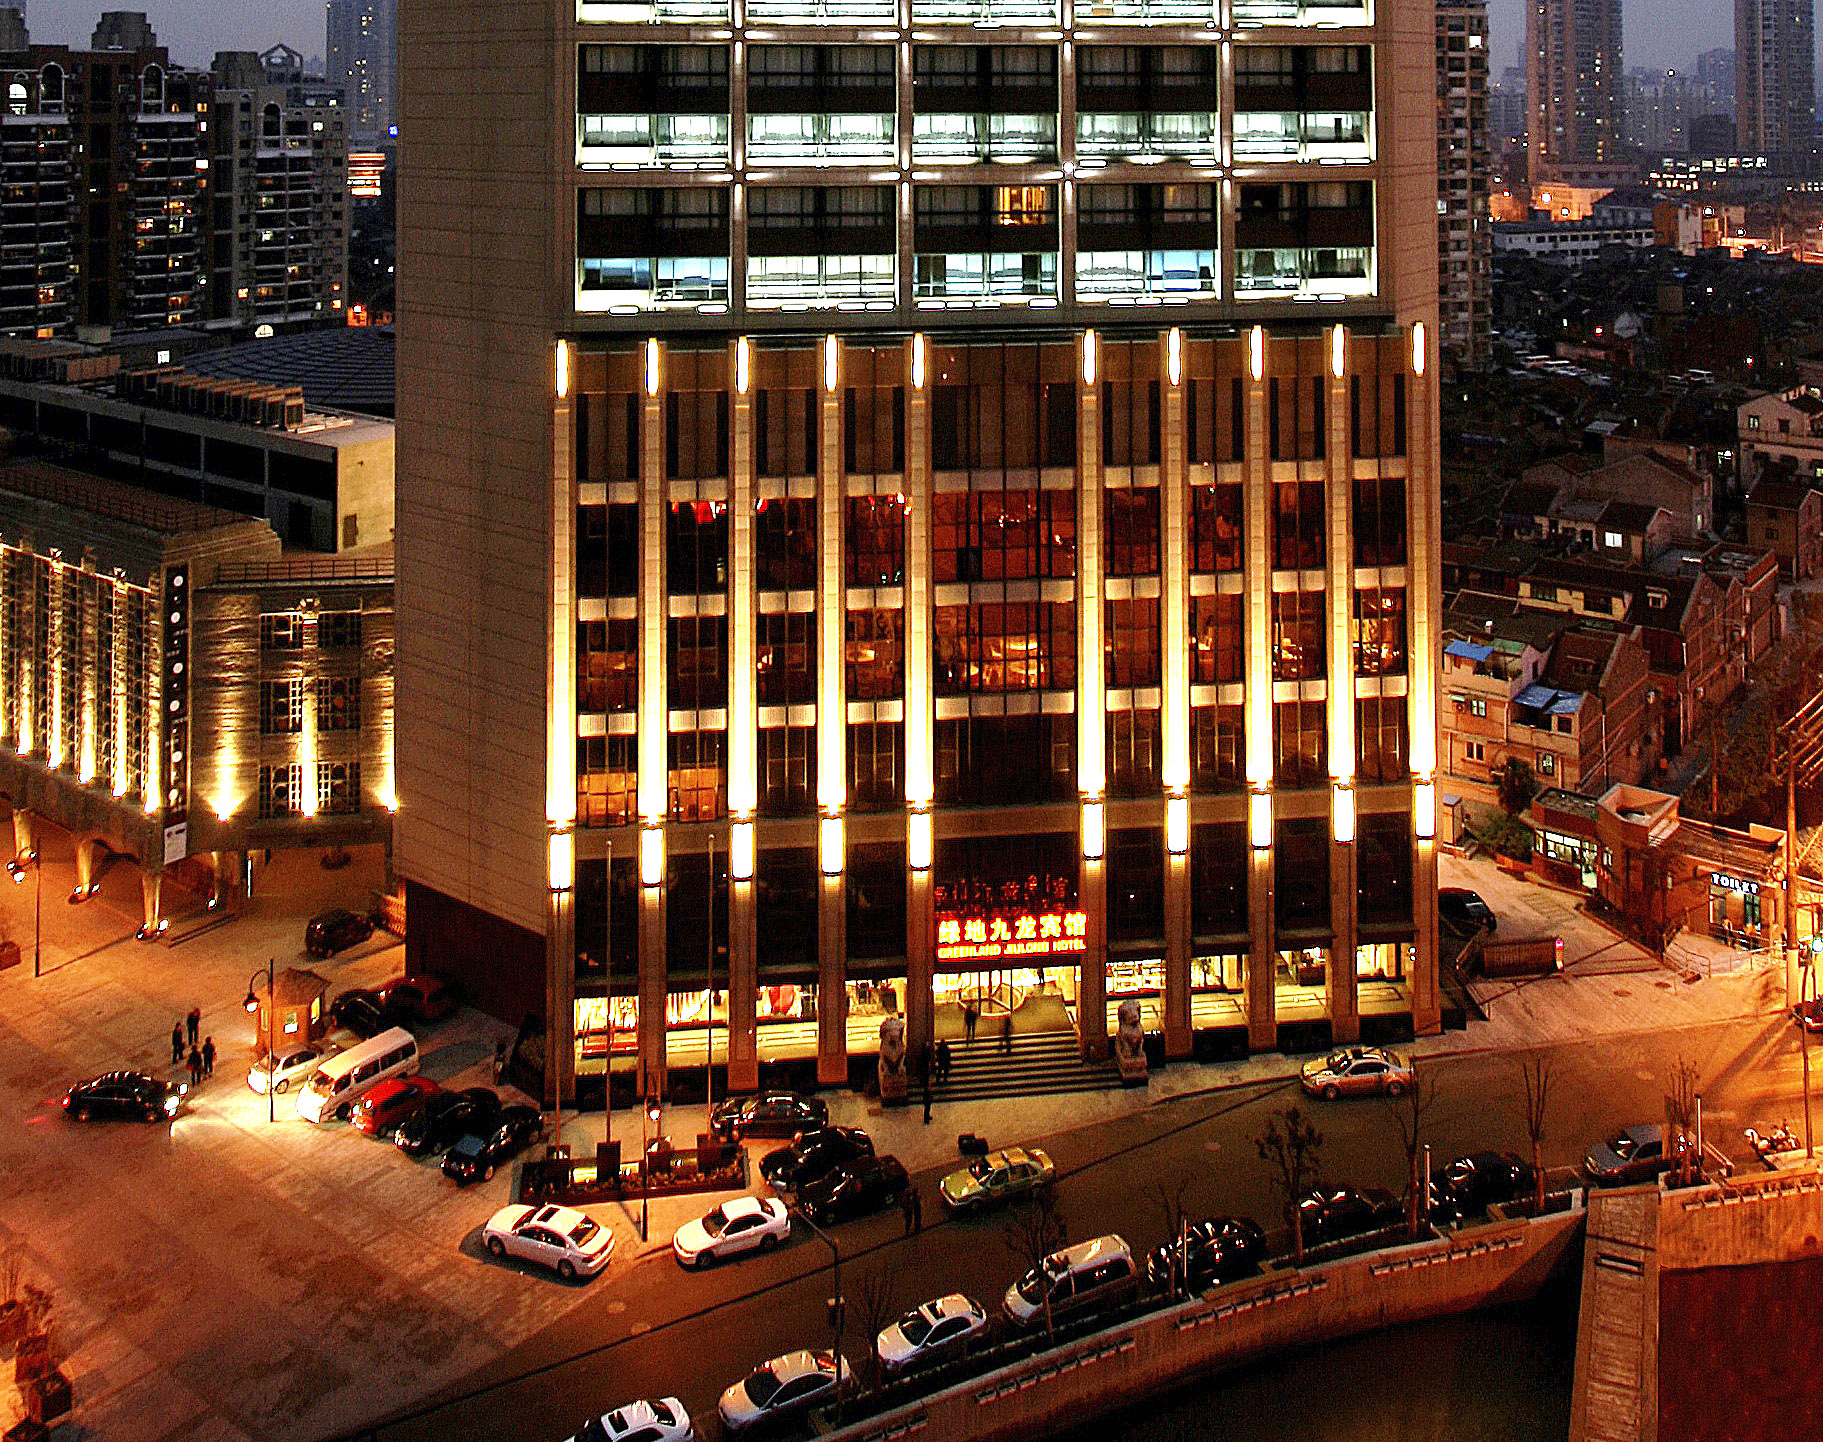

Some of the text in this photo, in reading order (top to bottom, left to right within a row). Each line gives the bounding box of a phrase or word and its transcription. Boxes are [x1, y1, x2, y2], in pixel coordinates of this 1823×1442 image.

[1711, 872, 1759, 895] TOILET
[937, 944, 1001, 959] GREENLAND
[1052, 938, 1087, 952] HOTEL
